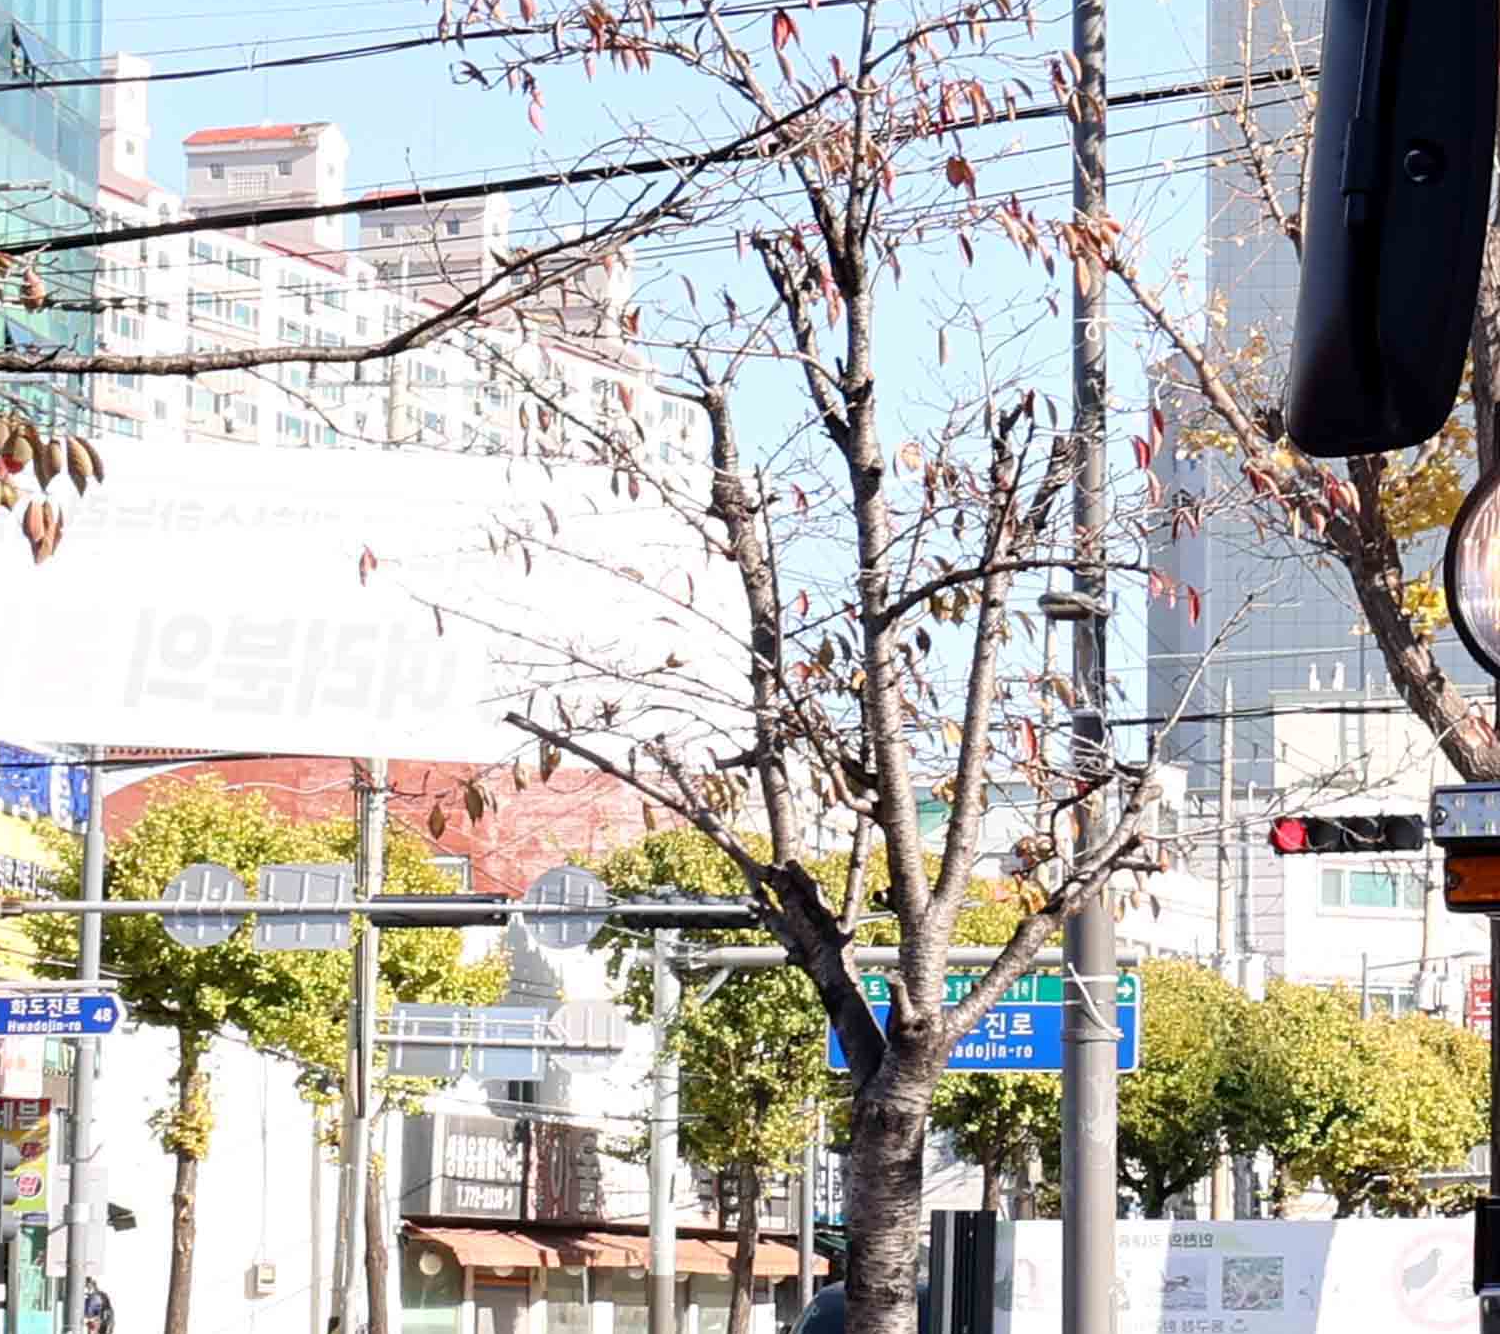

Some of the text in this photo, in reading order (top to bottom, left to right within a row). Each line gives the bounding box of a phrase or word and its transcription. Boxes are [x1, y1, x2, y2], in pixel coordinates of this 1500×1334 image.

[9, 998, 82, 1017] 화도진로
[92, 1008, 113, 1023] 48
[949, 1043, 1034, 1061] adojin-ro
